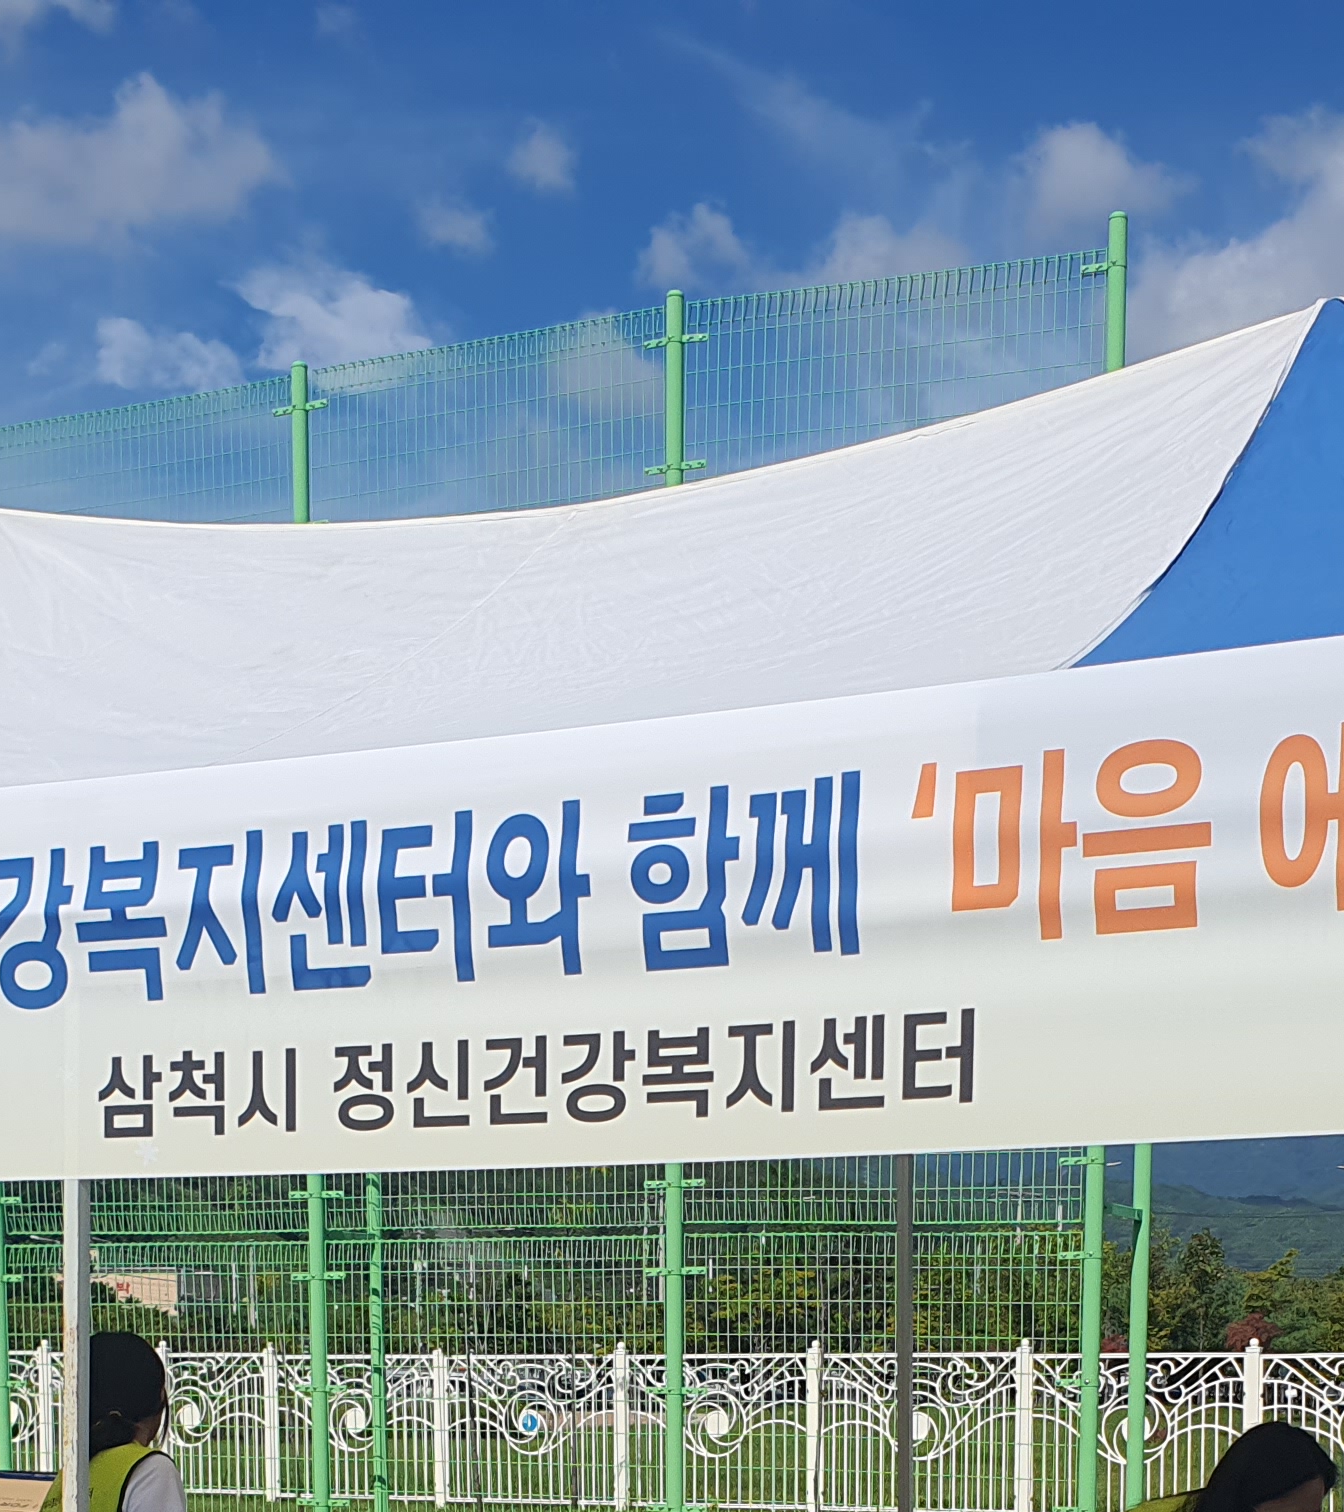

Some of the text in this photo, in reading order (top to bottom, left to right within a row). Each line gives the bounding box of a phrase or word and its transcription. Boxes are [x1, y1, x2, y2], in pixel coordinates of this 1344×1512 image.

[626, 769, 862, 973] 함께
[96, 1007, 977, 1139] 삼척시 정신건강복지센터
